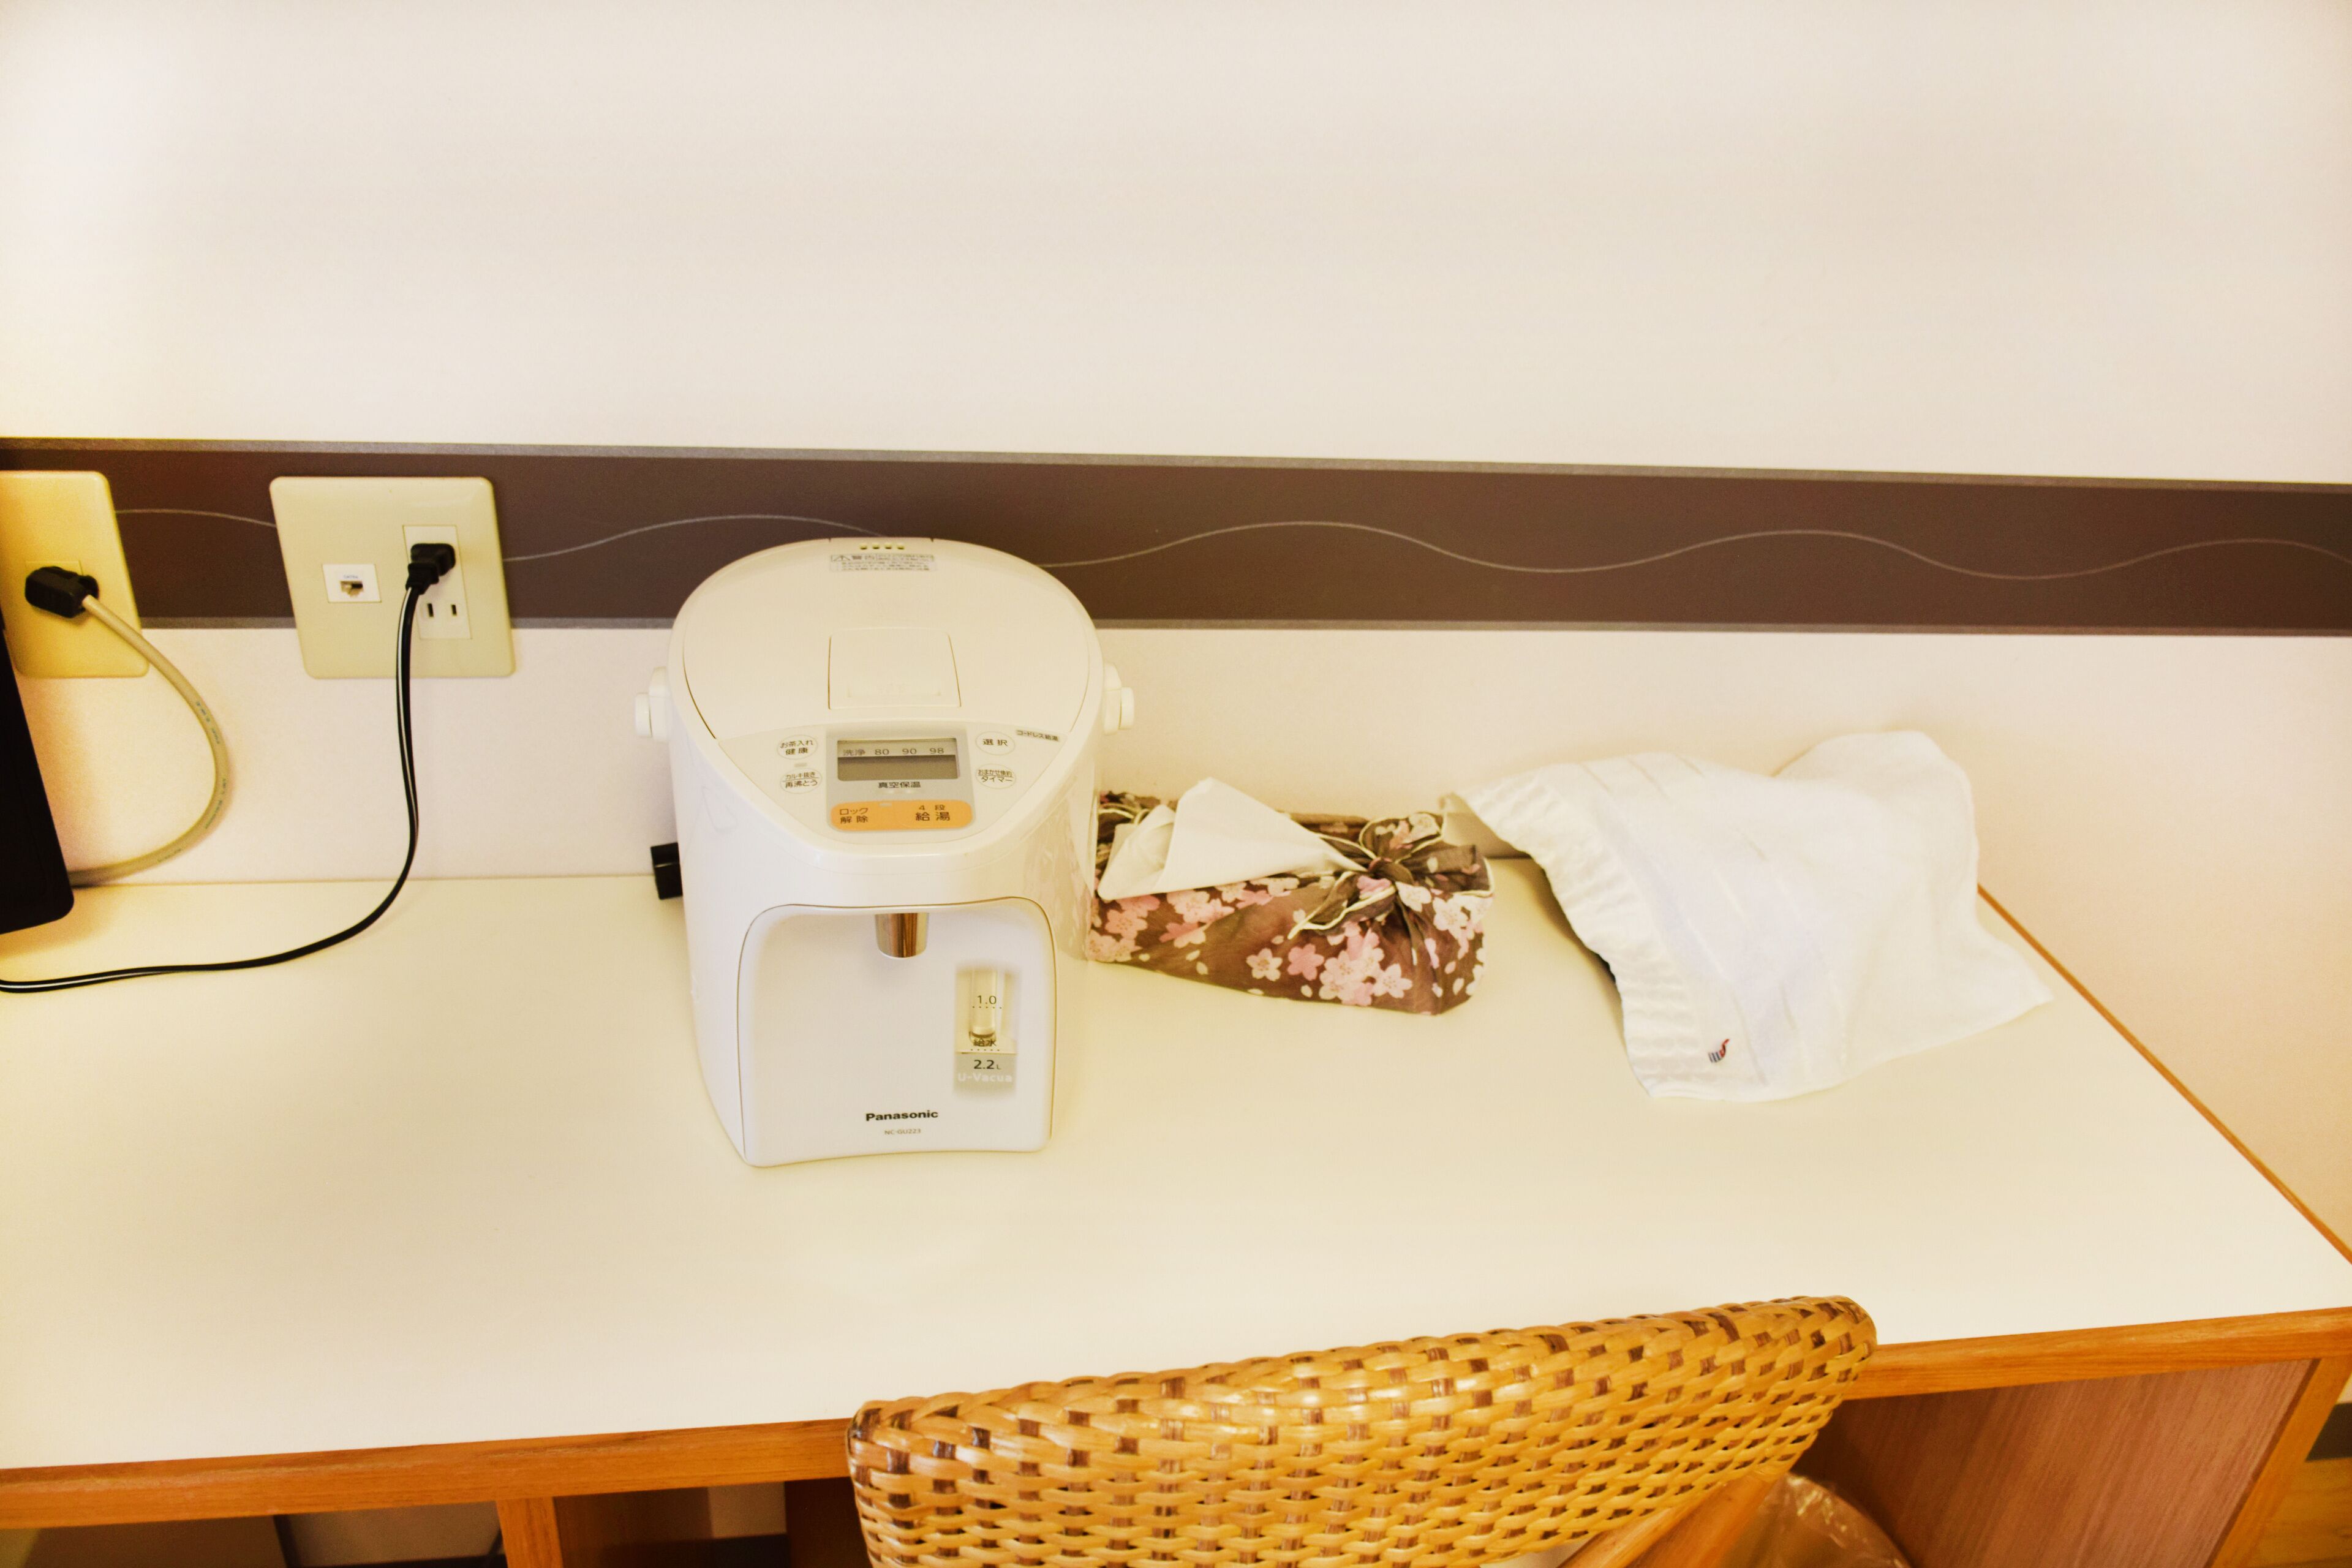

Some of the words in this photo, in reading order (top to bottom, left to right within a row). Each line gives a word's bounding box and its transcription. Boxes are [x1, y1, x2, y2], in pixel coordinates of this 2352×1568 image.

[840, 815, 868, 824] 解除
[916, 812, 950, 821] 給湯
[977, 995, 997, 1005] 1.0
[973, 1038, 997, 1047] 給水
[957, 1072, 1012, 1082] U-Vacua
[865, 1110, 938, 1121] Panasonic
